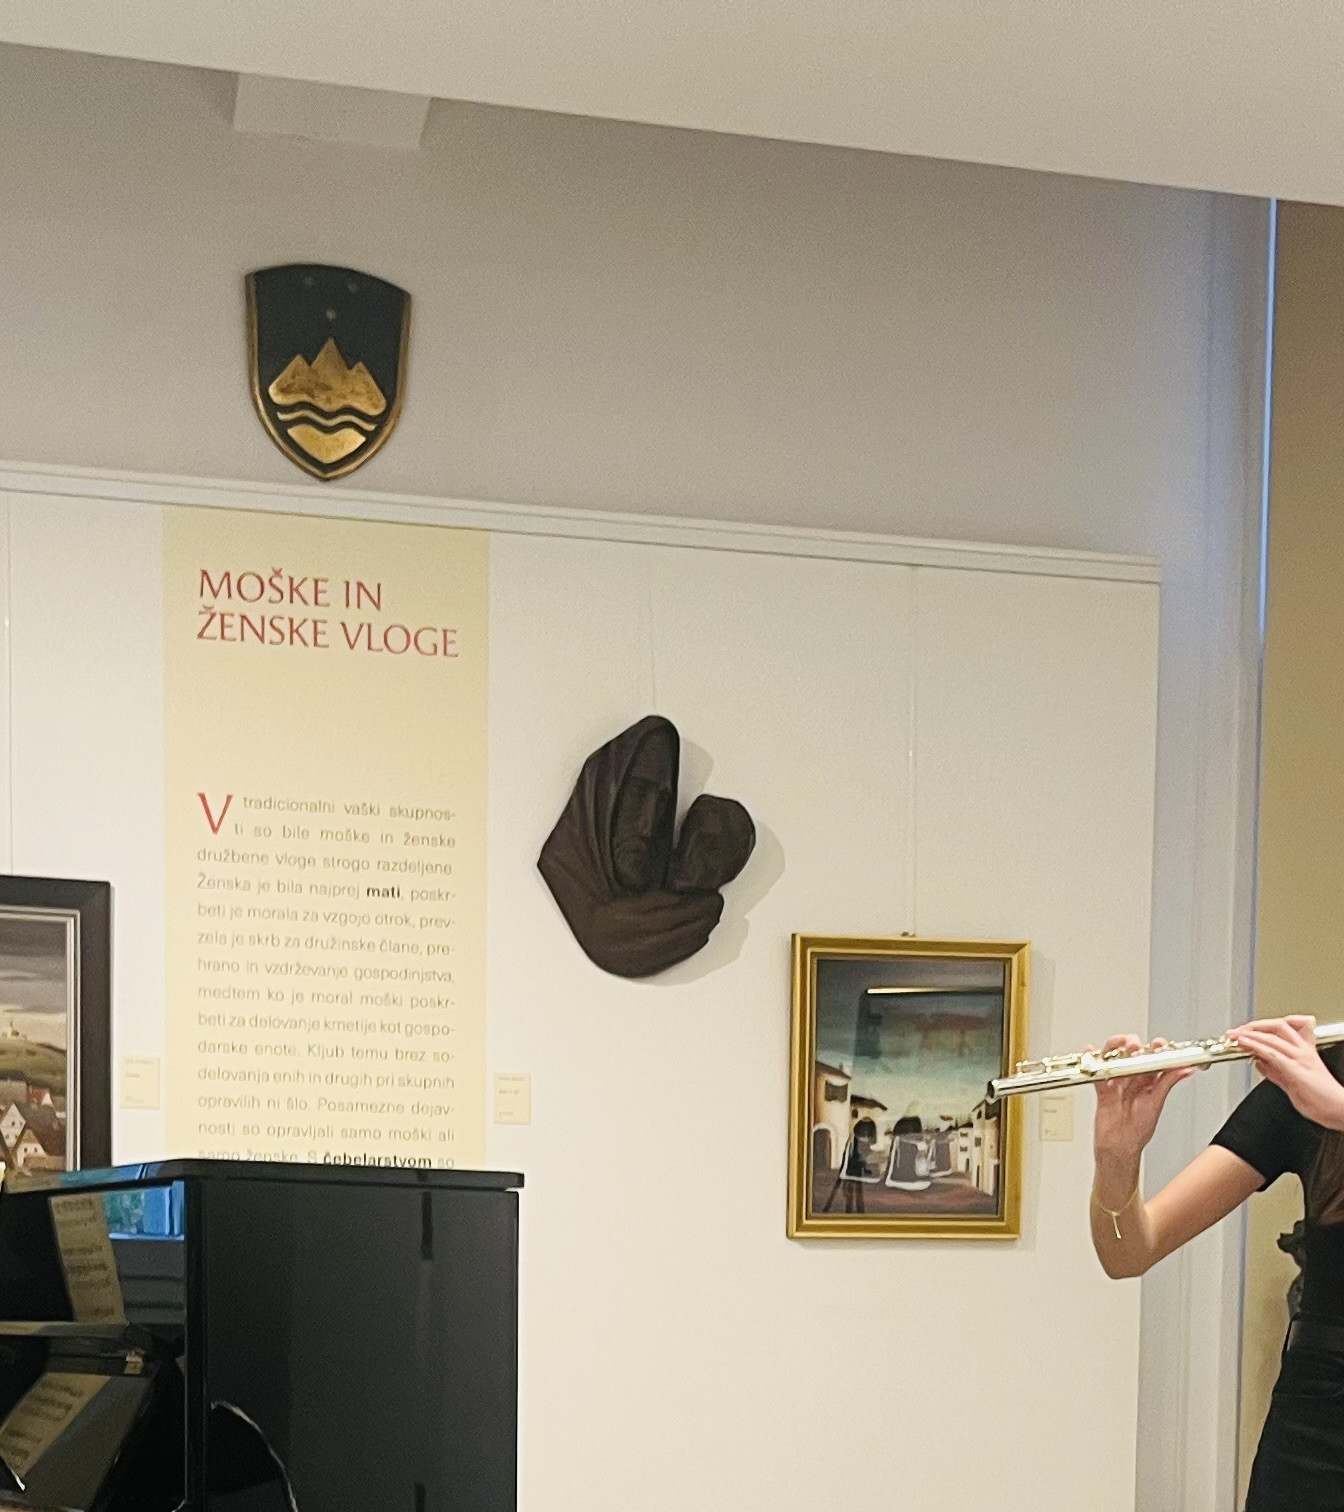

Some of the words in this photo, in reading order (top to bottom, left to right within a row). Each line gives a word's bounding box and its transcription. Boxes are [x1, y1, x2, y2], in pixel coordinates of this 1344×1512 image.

[199, 567, 331, 608] MOŠKE
[344, 580, 382, 612] IN
[196, 604, 330, 649] ŽENSKE
[340, 620, 459, 658] VLOGE
[197, 793, 233, 834] V
[243, 797, 334, 813] tradicionalni
[344, 802, 380, 816] vaški
[381, 831, 393, 843] in
[404, 832, 455, 848] ženske
[198, 848, 269, 864] družbene
[276, 852, 315, 869] vloge
[323, 856, 370, 871] strogo
[197, 873, 251, 891] Ženska
[277, 879, 302, 893] bila
[323, 912, 370, 927] vzgojo
[375, 915, 415, 928] otrok,
[305, 936, 375, 952] družinske
[265, 962, 347, 979] vzdrževanje
[198, 986, 259, 1001] medtem
[312, 992, 352, 1004] moral
[360, 994, 403, 1006] moški
[249, 1015, 320, 1032] delovanje
[324, 1018, 376, 1035] kmetije
[198, 1040, 247, 1055] darske
[308, 1044, 344, 1060] Kljub
[351, 1046, 388, 1061] temu
[395, 1048, 425, 1062] brez
[325, 1074, 372, 1089] drugih
[398, 1076, 454, 1090] skupnih
[198, 1095, 260, 1110] opravilih
[318, 1097, 404, 1114] Posamezne
[267, 1123, 333, 1139] opravljali
[341, 1129, 381, 1140] samo
[389, 1127, 431, 1141] moški
